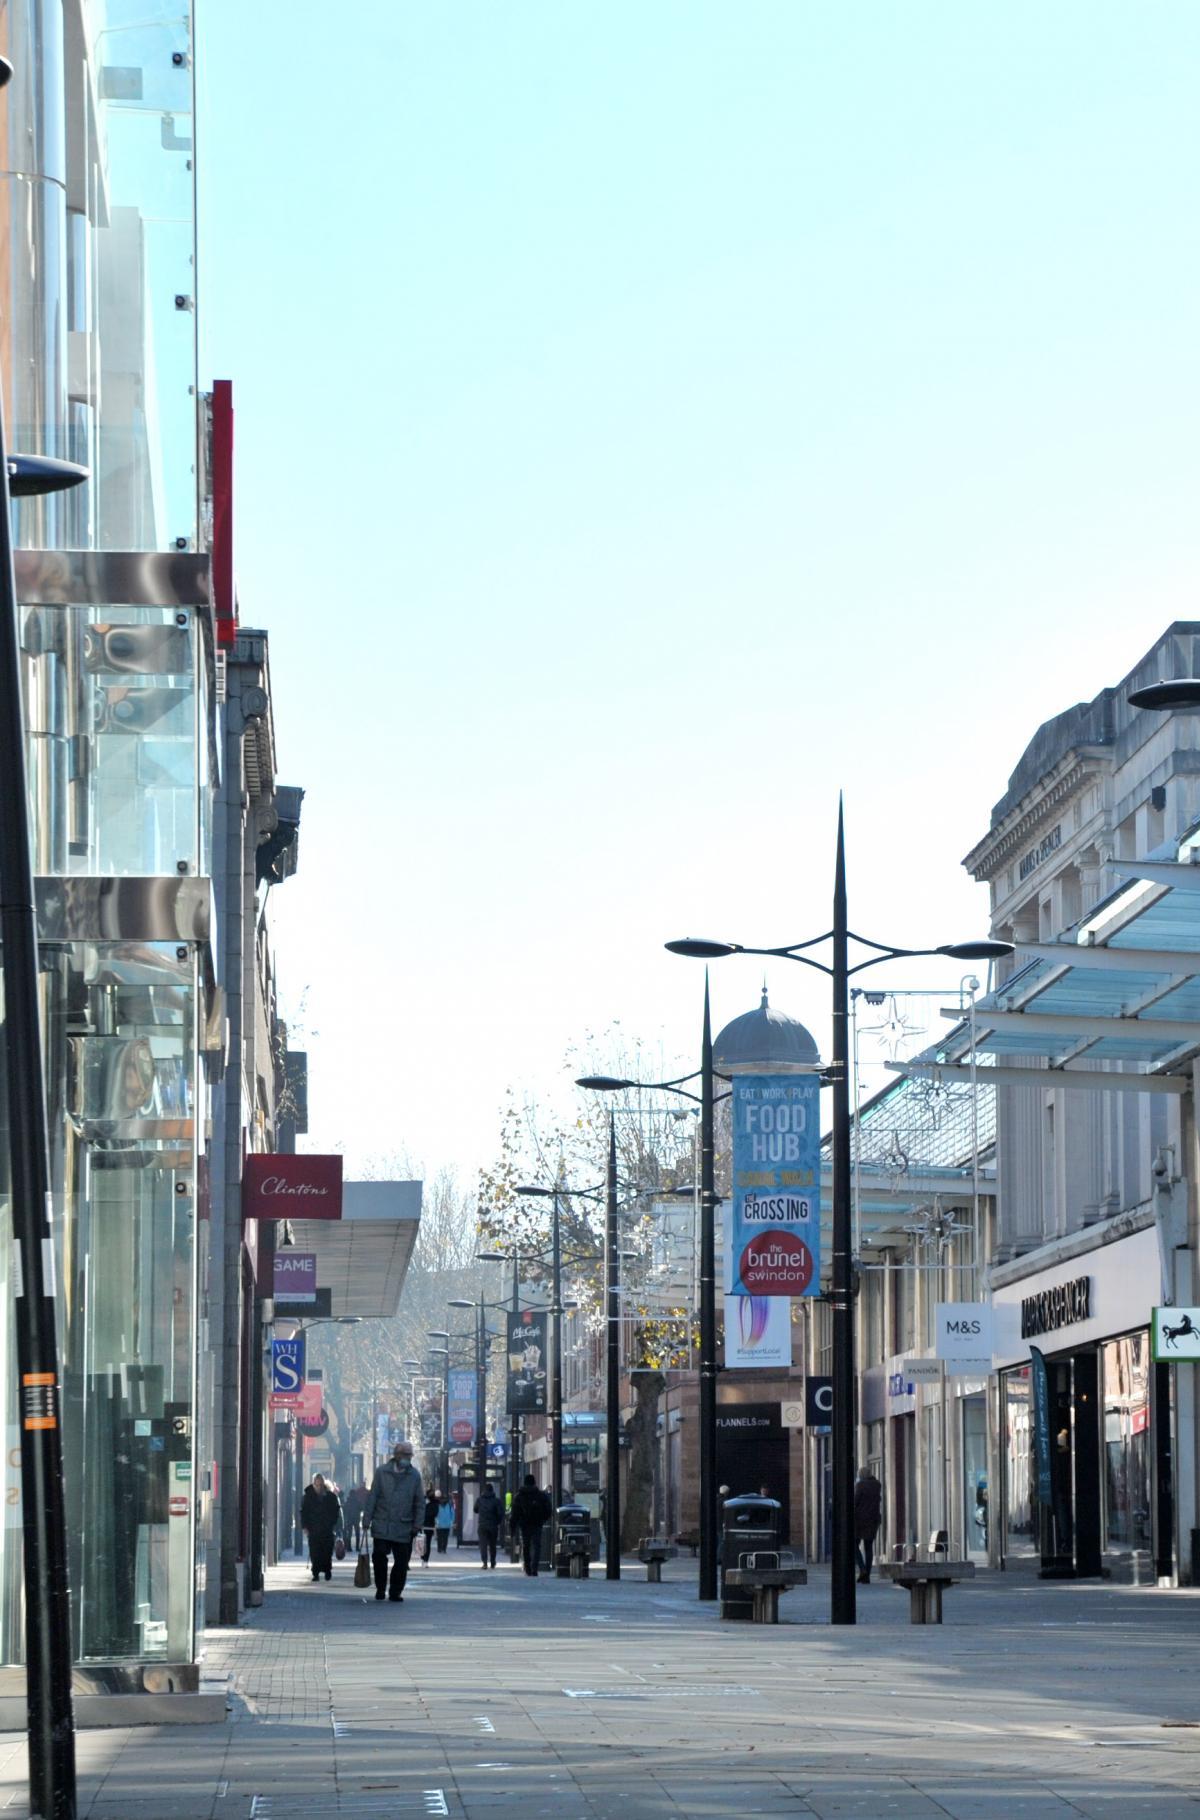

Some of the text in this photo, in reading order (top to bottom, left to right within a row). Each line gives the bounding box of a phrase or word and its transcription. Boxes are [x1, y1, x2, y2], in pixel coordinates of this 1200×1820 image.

[740, 1087, 815, 1099] EAT WORK PLAY
[745, 1104, 806, 1133] FOOD
[752, 1133, 800, 1162] HUB
[260, 1176, 329, 1196] Clintons
[744, 1198, 808, 1220] CROSSING
[273, 1259, 313, 1272] GAME
[747, 1248, 805, 1267] brunel
[747, 1269, 805, 1281] swindon
[946, 1320, 981, 1334] M&S
[275, 1343, 298, 1354] WH
[275, 1354, 298, 1390] S
